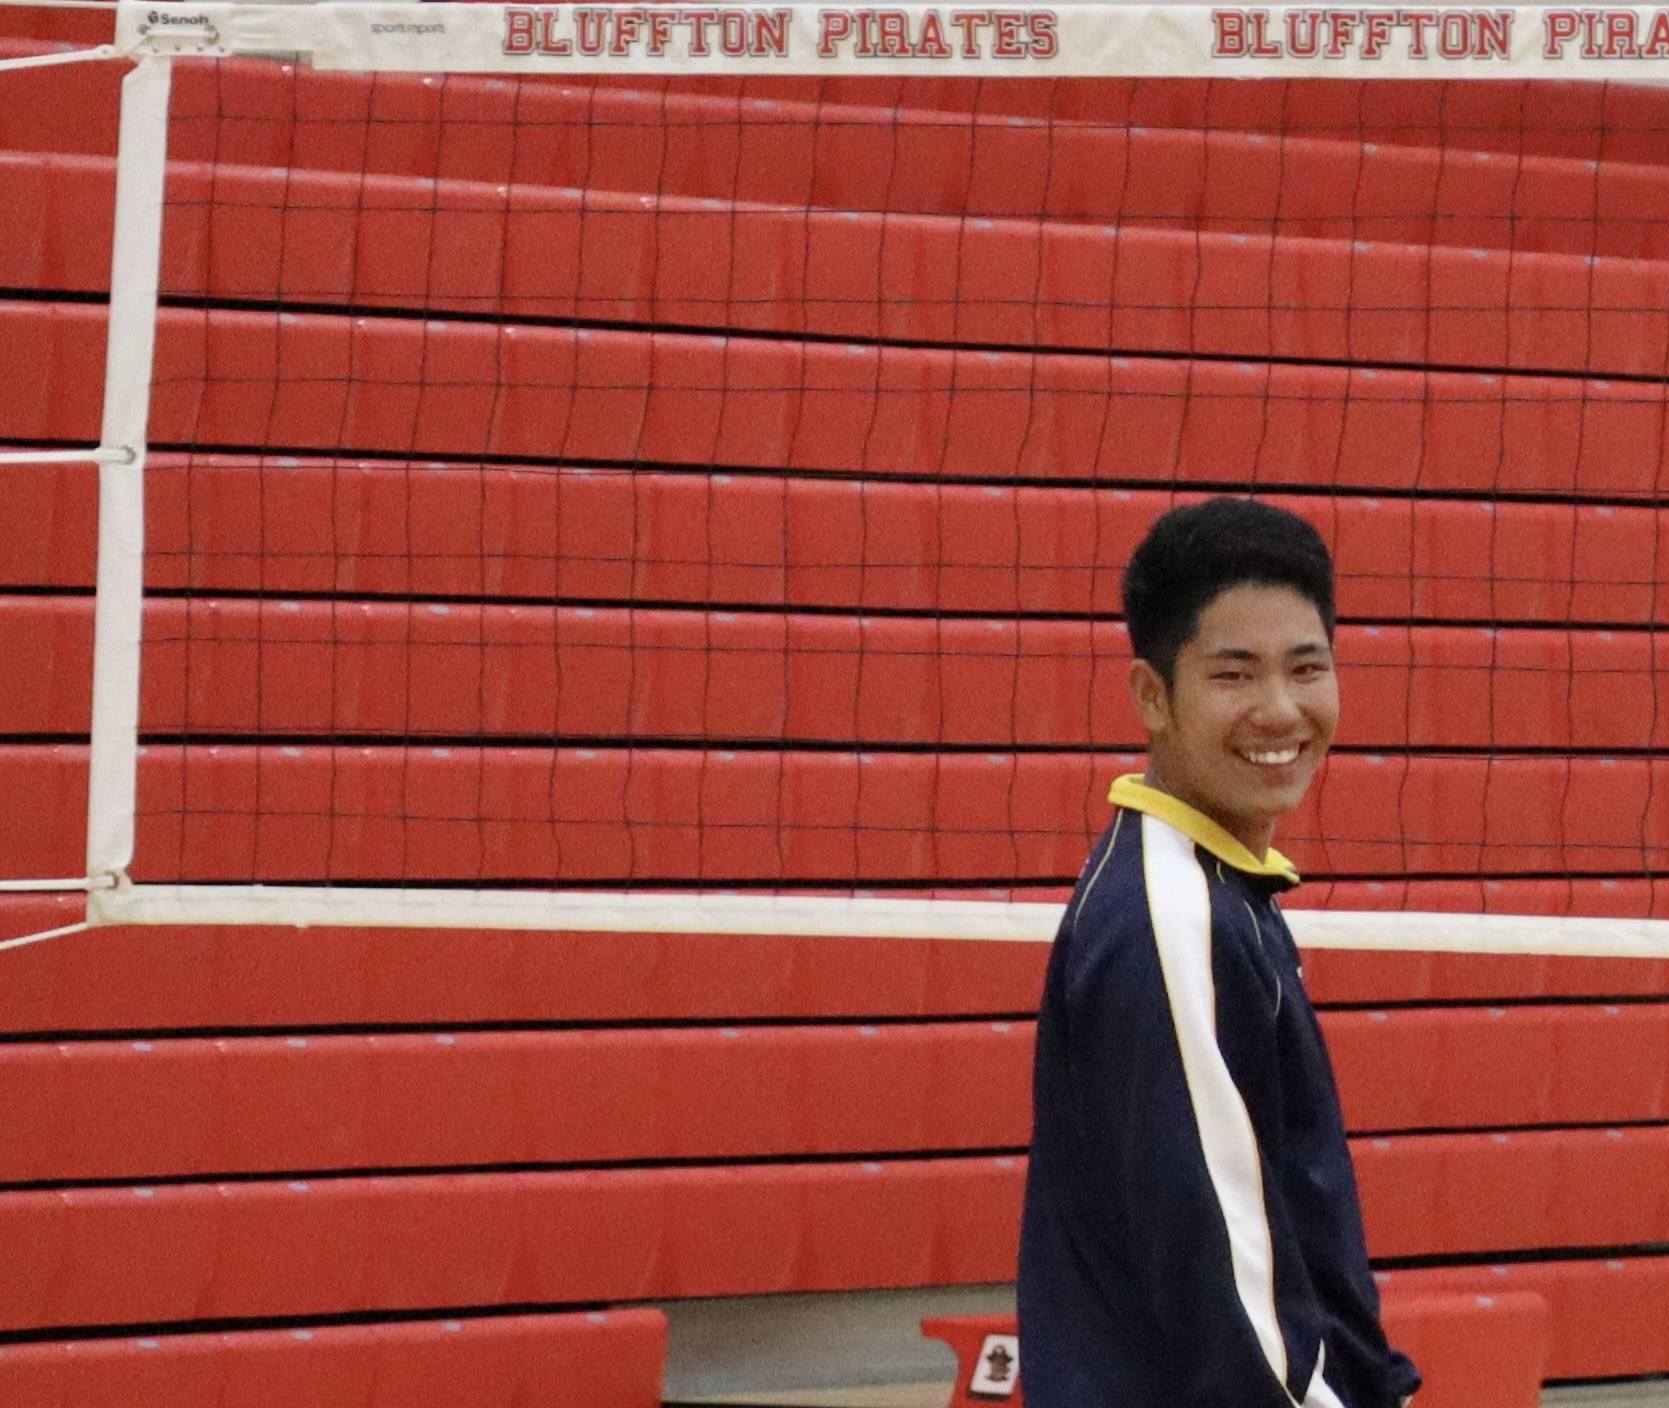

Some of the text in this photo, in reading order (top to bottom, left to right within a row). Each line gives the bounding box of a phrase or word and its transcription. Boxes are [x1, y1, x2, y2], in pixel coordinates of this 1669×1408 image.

[502, 8, 1059, 58] BLUFFTON PIRATES
[1209, 8, 1511, 58] BLUFFTON
